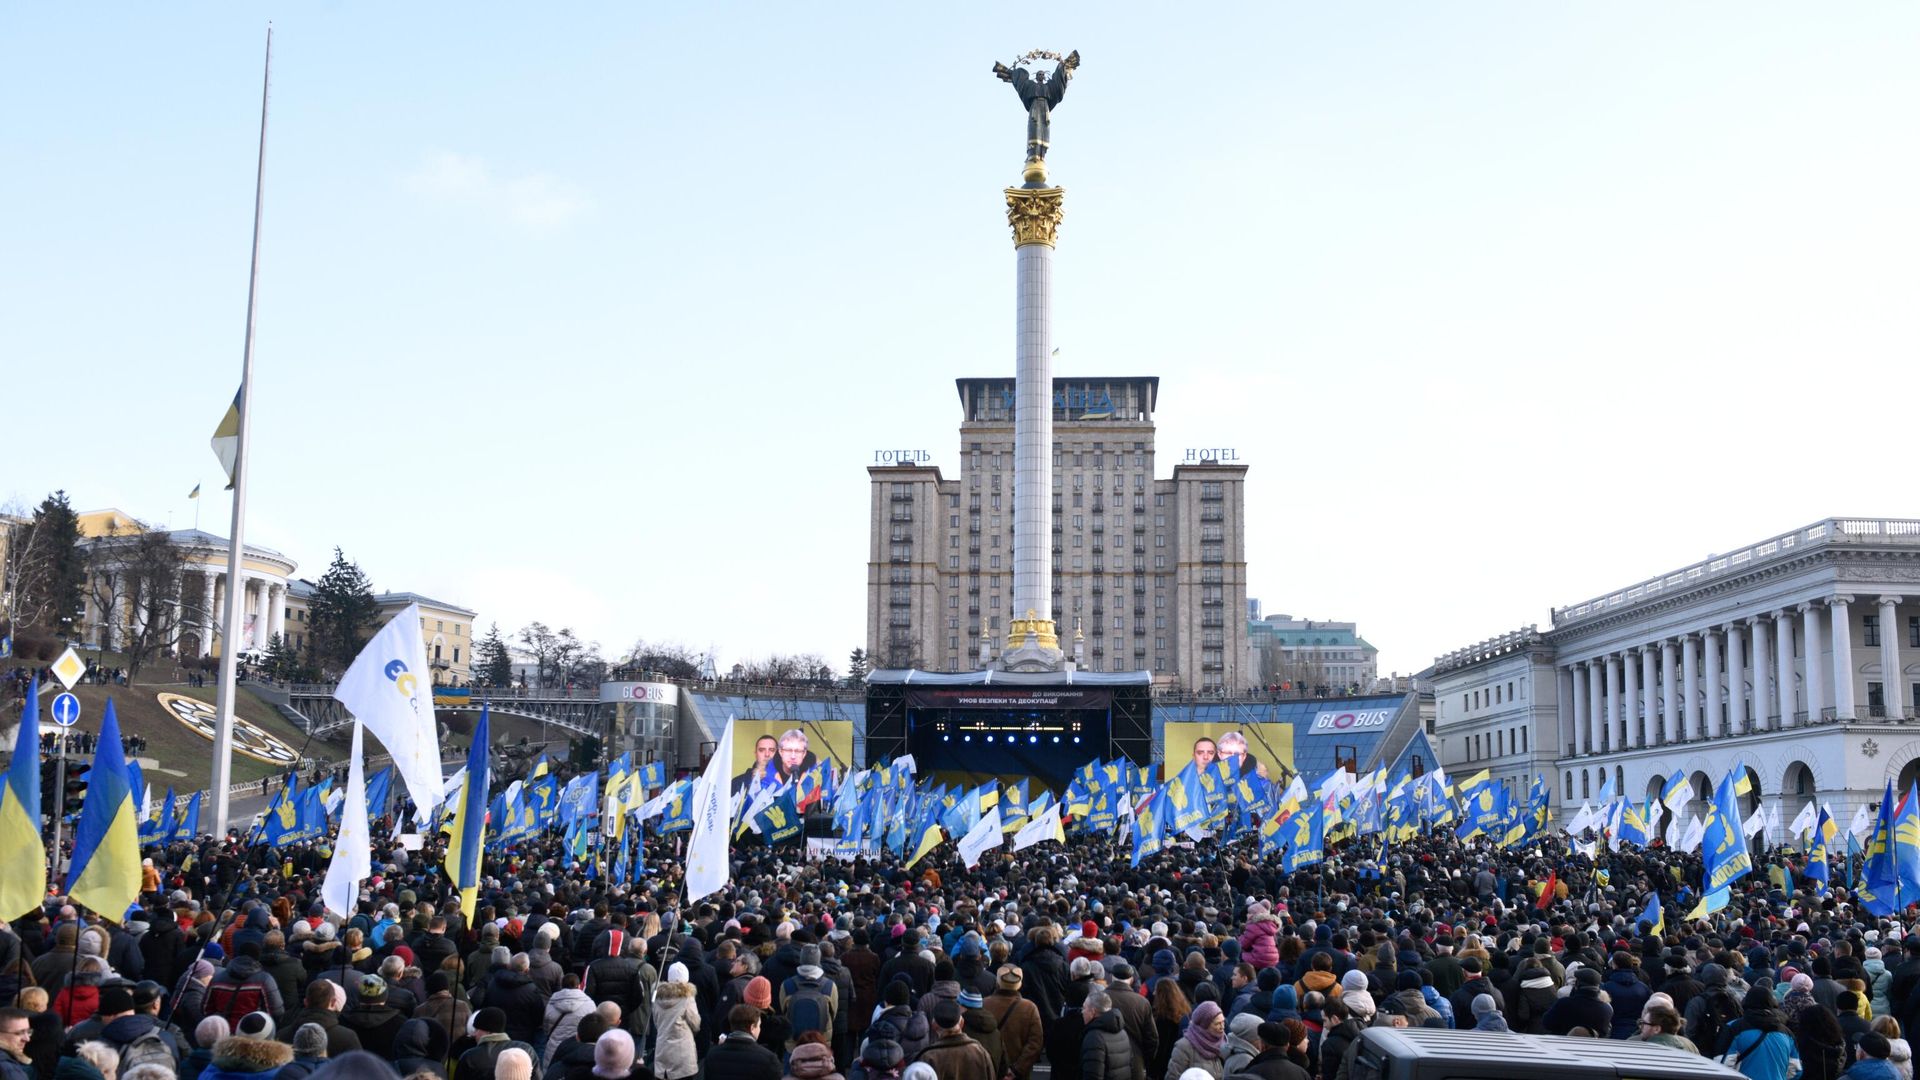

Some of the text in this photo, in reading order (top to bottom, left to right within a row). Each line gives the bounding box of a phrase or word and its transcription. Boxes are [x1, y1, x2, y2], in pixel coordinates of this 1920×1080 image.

[1001, 387, 1114, 409] УАЇНА
[875, 449, 931, 462] ГОТЕЛЬ
[1186, 448, 1240, 460] HOTEL
[623, 686, 664, 700] GLOBUS
[1317, 710, 1388, 729] GLOBUS
